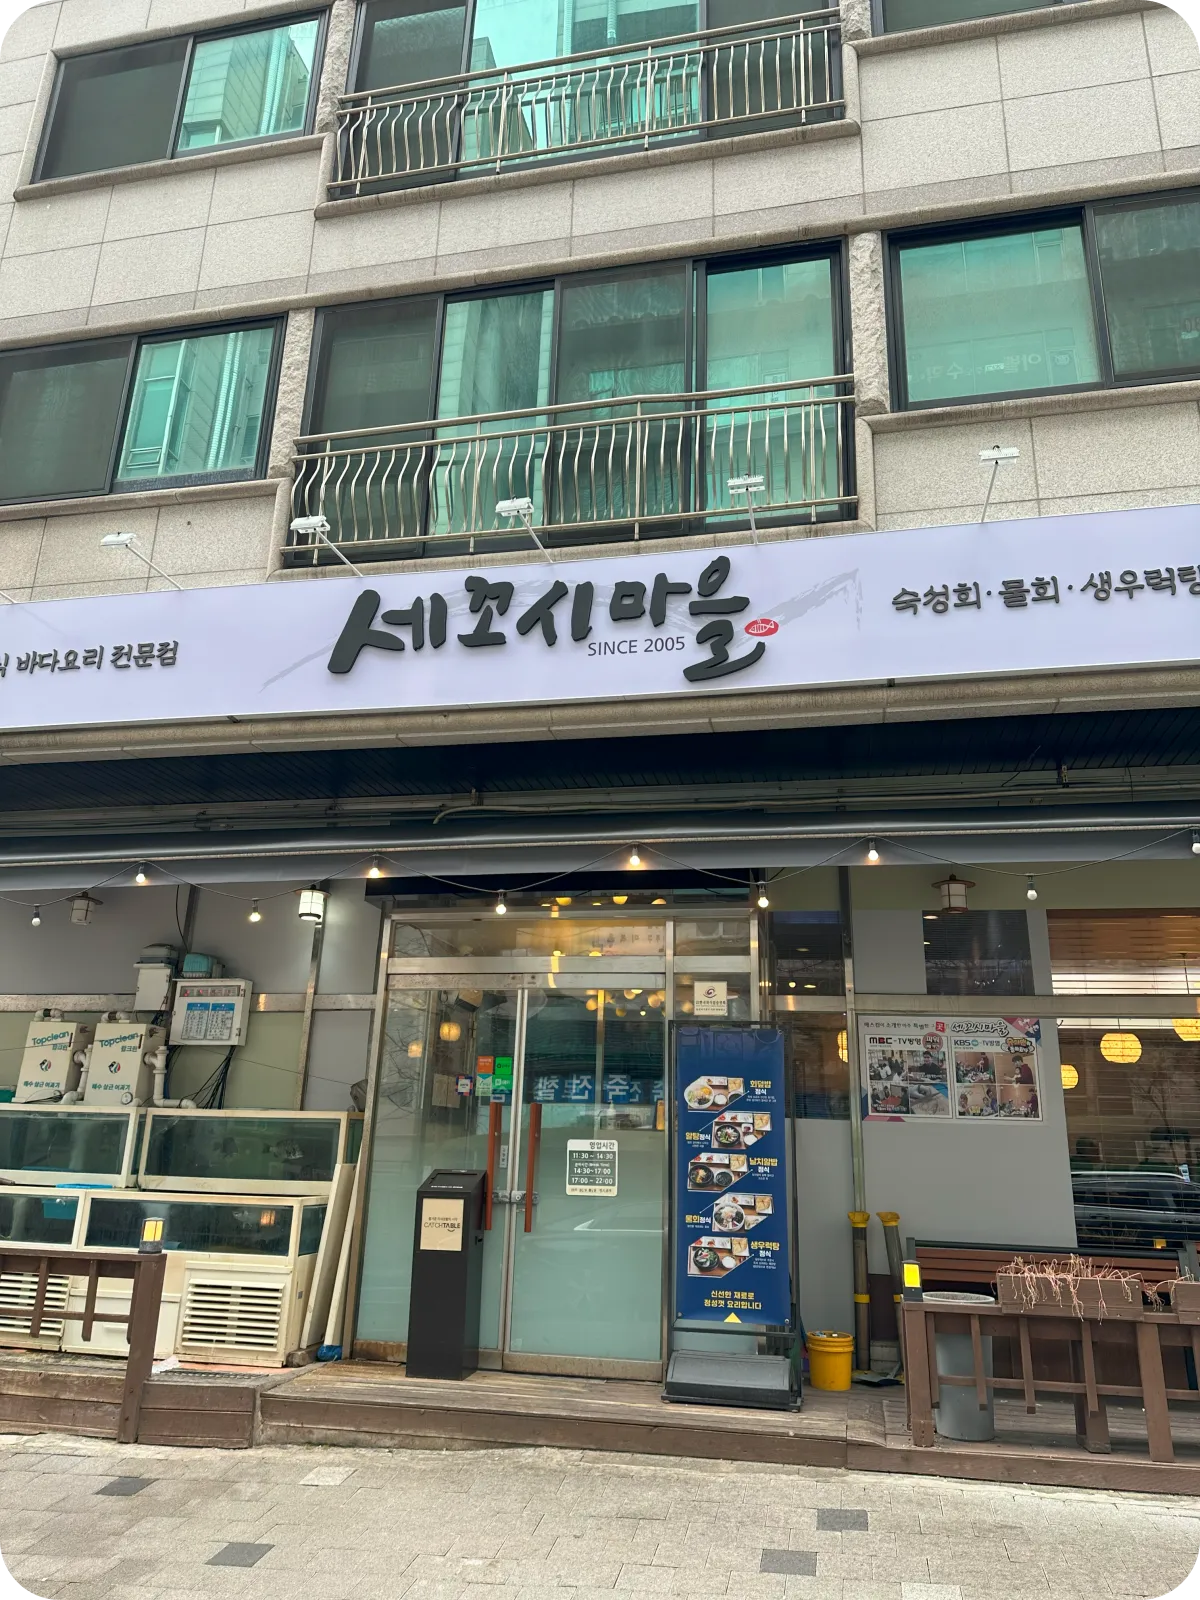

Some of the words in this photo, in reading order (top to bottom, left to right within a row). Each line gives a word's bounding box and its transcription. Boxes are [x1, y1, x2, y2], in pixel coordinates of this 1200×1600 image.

[327, 555, 765, 683] 세꼬시마을
[587, 639, 638, 656] SINCE
[644, 635, 686, 653] 2005
[16, 645, 104, 676] 바다요리
[110, 640, 179, 669] 전문점
[951, 1020, 1010, 1037] 세꼬시마을
[32, 1031, 70, 1046] Topclean
[99, 1032, 139, 1048] Topclean
[750, 1080, 771, 1088] 회덮밥
[589, 1141, 615, 1150] 영업시간
[750, 1241, 780, 1251] 생우럭탕
[759, 1250, 772, 1258] 정식
[710, 1289, 732, 1298] 신선한
[733, 1291, 755, 1300] 재료로
[704, 1299, 725, 1308] 정성껏
[727, 1300, 762, 1310] 요리합니다
